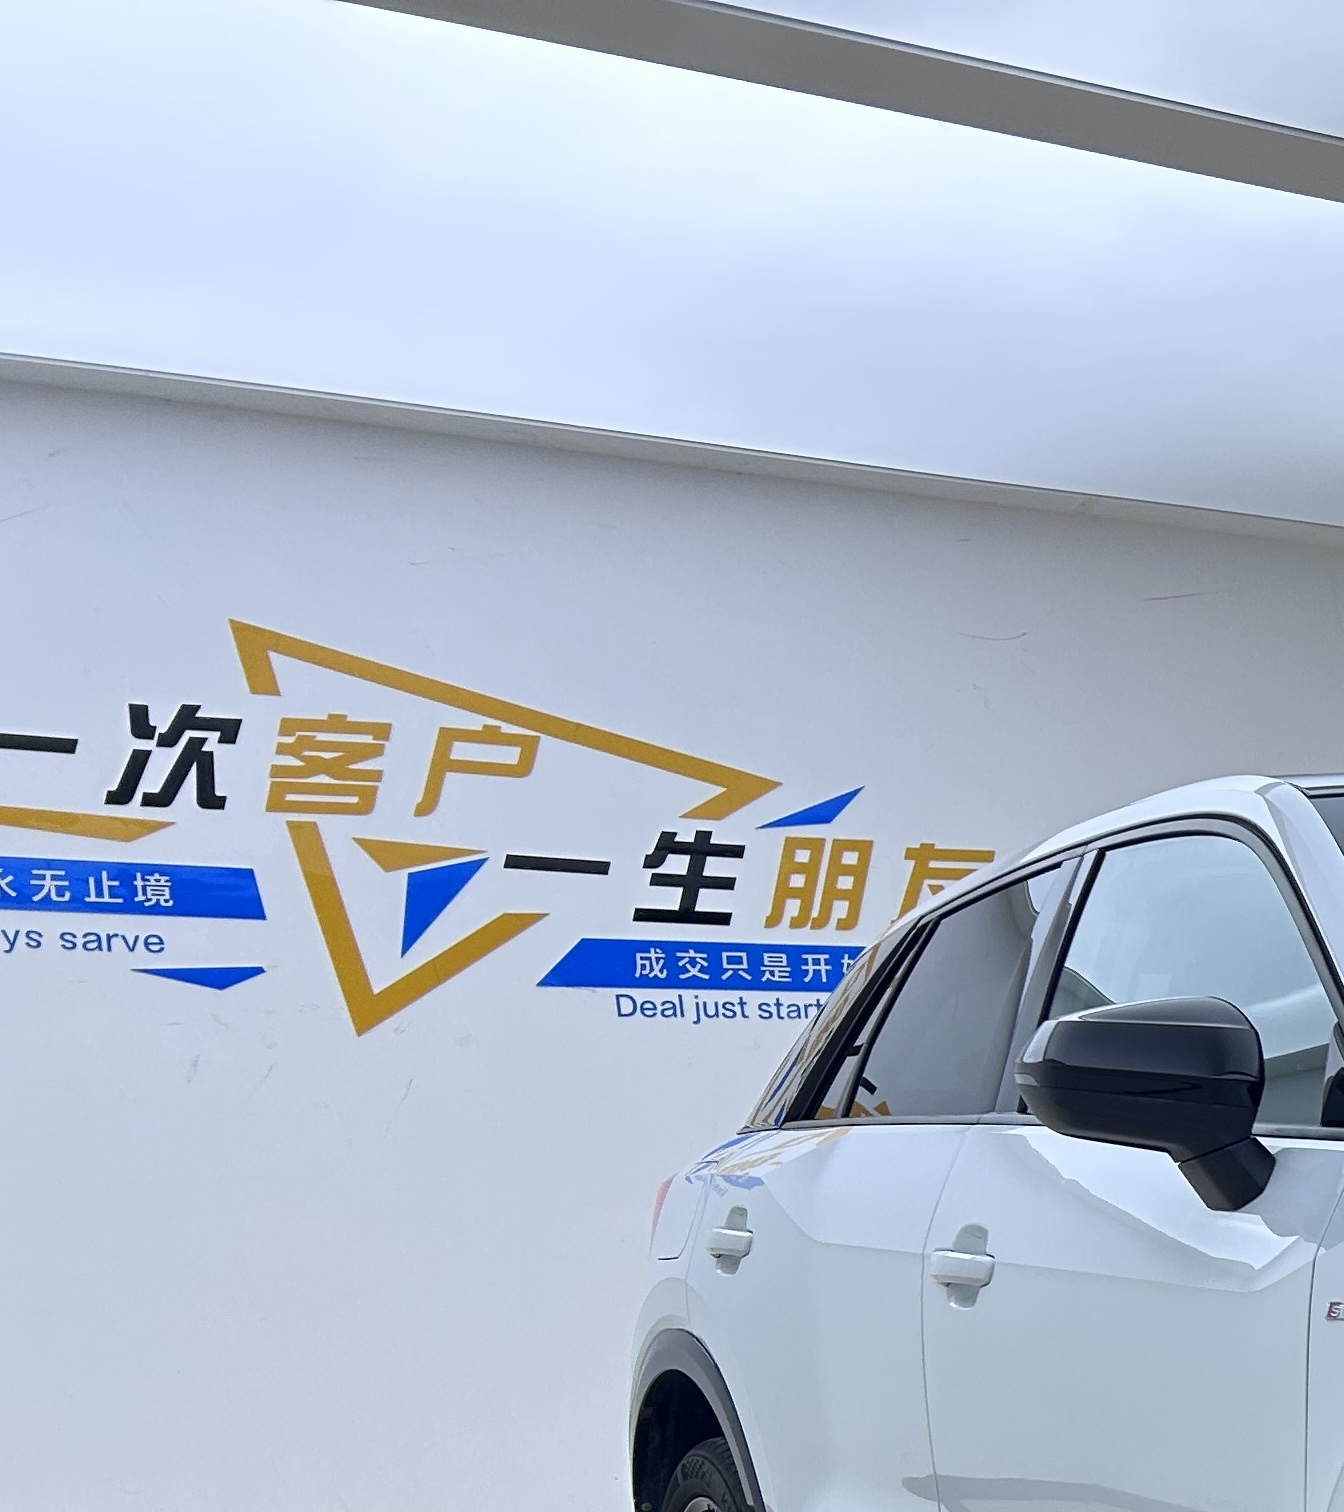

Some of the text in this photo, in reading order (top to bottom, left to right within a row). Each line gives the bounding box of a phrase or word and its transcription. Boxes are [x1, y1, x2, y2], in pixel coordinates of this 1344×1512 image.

[59, 931, 166, 954] sarve
[615, 993, 685, 1019] Deal
[692, 995, 749, 1025] just
